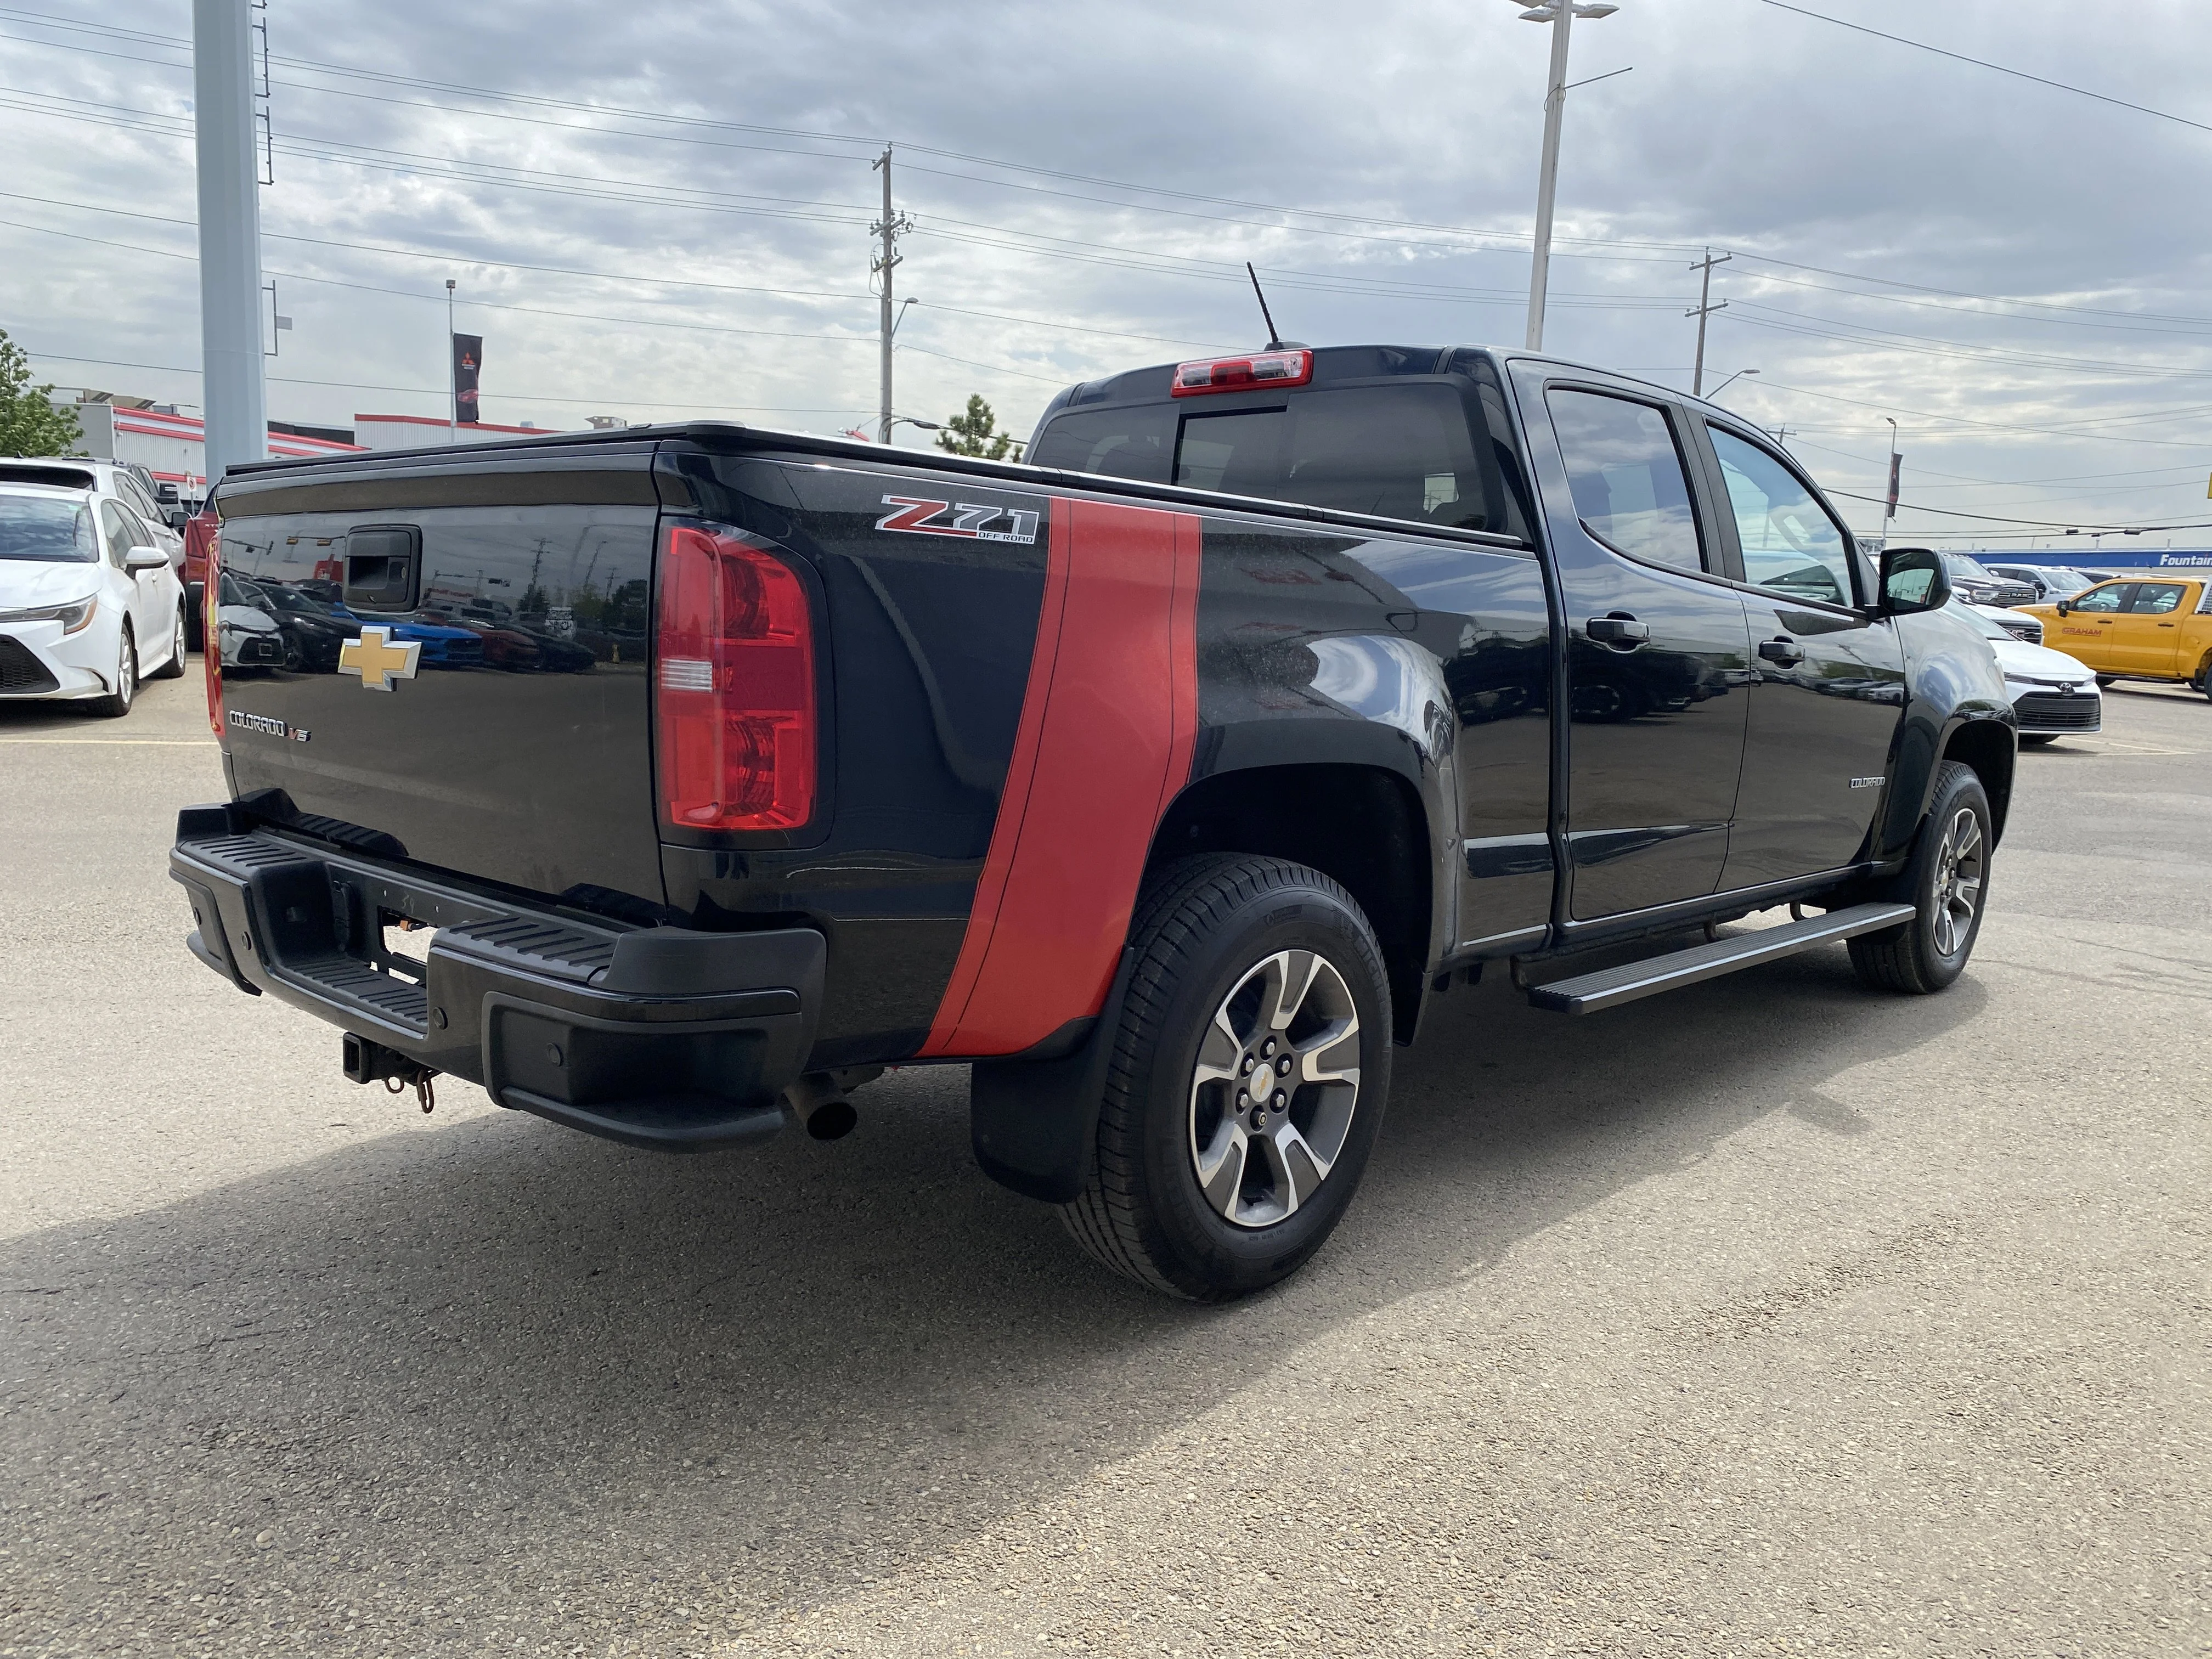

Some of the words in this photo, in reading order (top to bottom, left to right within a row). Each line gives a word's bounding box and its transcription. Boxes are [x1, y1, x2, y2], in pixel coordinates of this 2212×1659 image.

[875, 494, 1039, 539] Z71
[1003, 534, 1033, 543] ROAD
[2062, 627, 2102, 636] GRAHAM
[229, 710, 285, 737] COLORADO
[289, 727, 311, 742] V6
[1851, 776, 1886, 788] COLORADO
